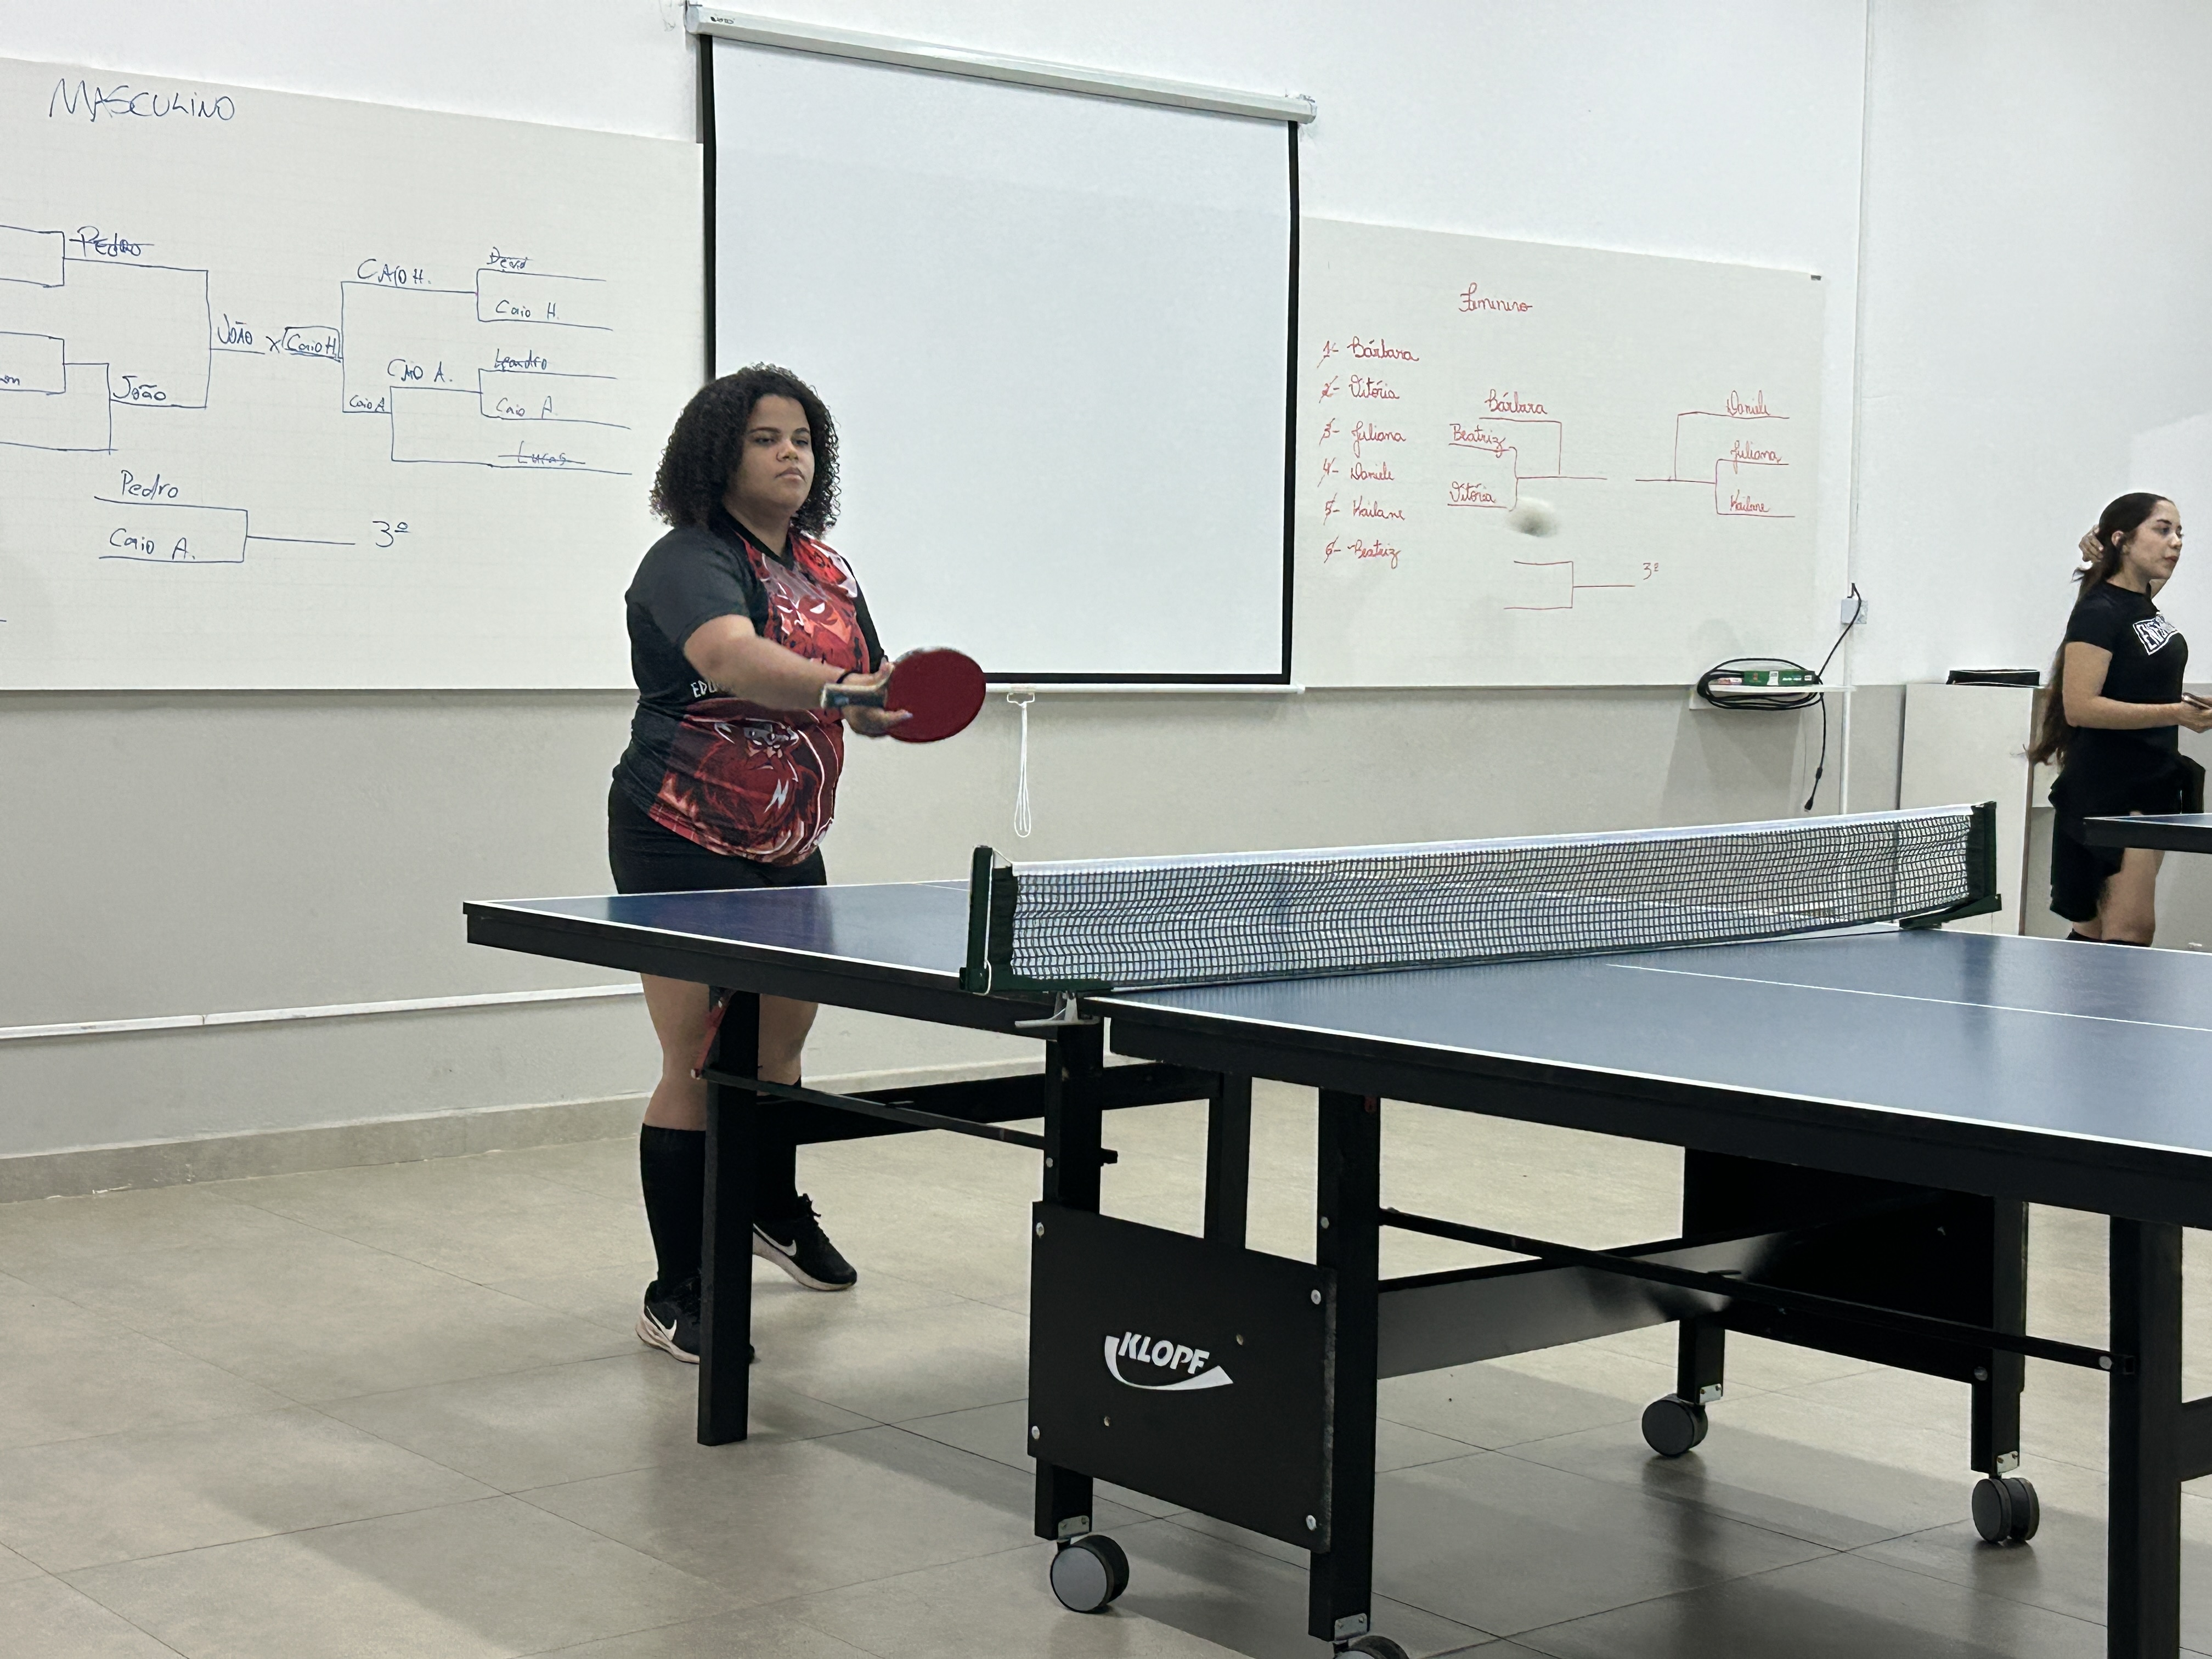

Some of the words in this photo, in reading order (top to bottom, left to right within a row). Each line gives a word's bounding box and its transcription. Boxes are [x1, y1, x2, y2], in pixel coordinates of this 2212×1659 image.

[49, 78, 234, 122] MASCULINO
[495, 299, 531, 318] Caio
[1458, 281, 1533, 312] Feminino
[1346, 335, 1420, 362] Bárbara
[112, 375, 166, 400] João
[1348, 374, 1400, 399] Vitória
[349, 394, 373, 409] Caio
[496, 397, 526, 417] Caio
[1484, 388, 1548, 415] Bárbara
[1351, 420, 1407, 459] Juliana
[1449, 423, 1506, 459] Beatriz
[121, 469, 179, 500] Pedro
[1449, 481, 1497, 503] Vitória
[109, 528, 155, 555] Caio
[1347, 539, 1402, 570] Beatriz
[1118, 1331, 1210, 1374] KLOPF
